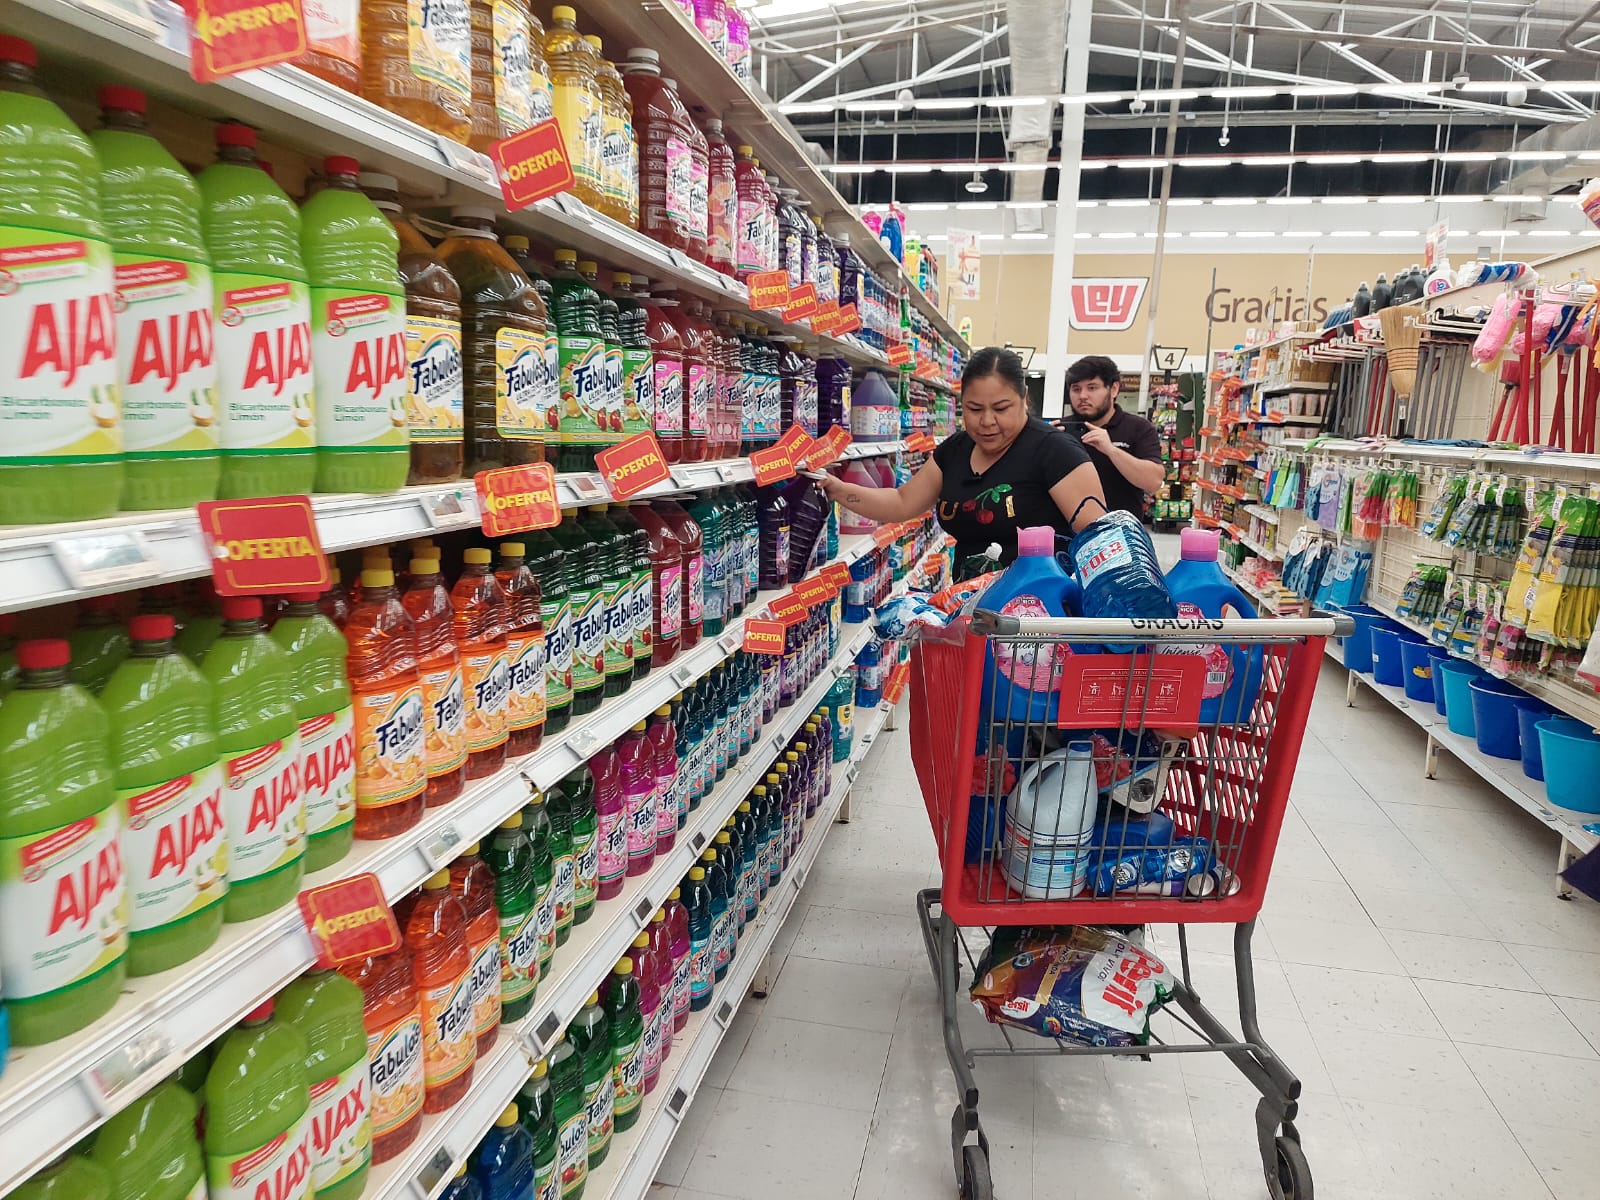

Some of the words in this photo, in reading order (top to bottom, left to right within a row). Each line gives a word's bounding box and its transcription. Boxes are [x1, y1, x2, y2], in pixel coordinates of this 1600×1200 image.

[508, 148, 564, 182] OFERTA
[757, 285, 787, 296] OFERTA
[1205, 287, 1328, 324] Gracias
[1164, 352, 1175, 366] 4
[615, 451, 660, 481] OFERTA
[760, 457, 790, 473] OFERTA
[495, 489, 552, 510] OFERTA
[230, 535, 316, 561] OFERTA
[800, 586, 825, 600] OFERTA
[778, 603, 803, 618] OFERTA
[750, 633, 782, 642] OFERTA
[149, 787, 225, 880] AJAX
[326, 905, 388, 935] OFERTA
